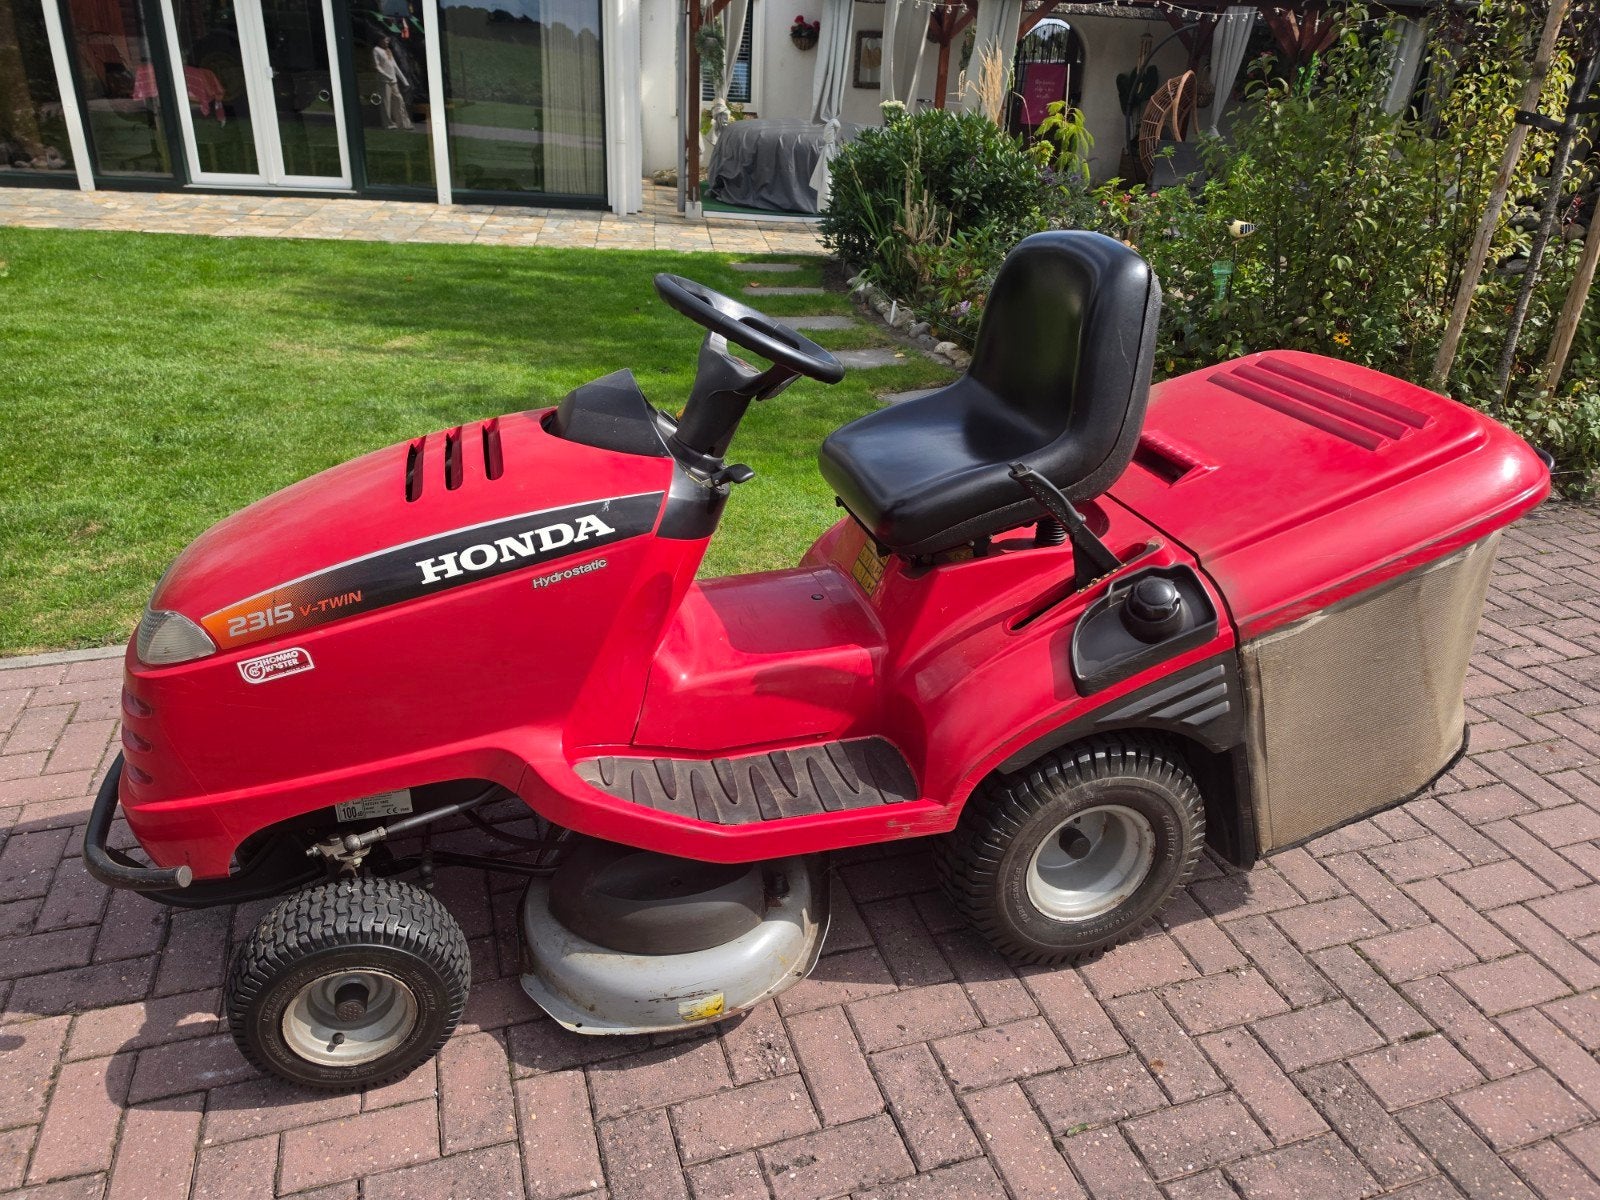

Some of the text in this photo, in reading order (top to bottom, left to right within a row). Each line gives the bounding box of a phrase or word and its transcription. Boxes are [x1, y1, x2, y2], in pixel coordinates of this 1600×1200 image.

[415, 514, 616, 585] HONDA
[532, 559, 607, 589] Hydrostatic
[227, 590, 363, 637] 2315 V-TWIN
[263, 651, 299, 666] HOMMO
[342, 806, 357, 819] 100
